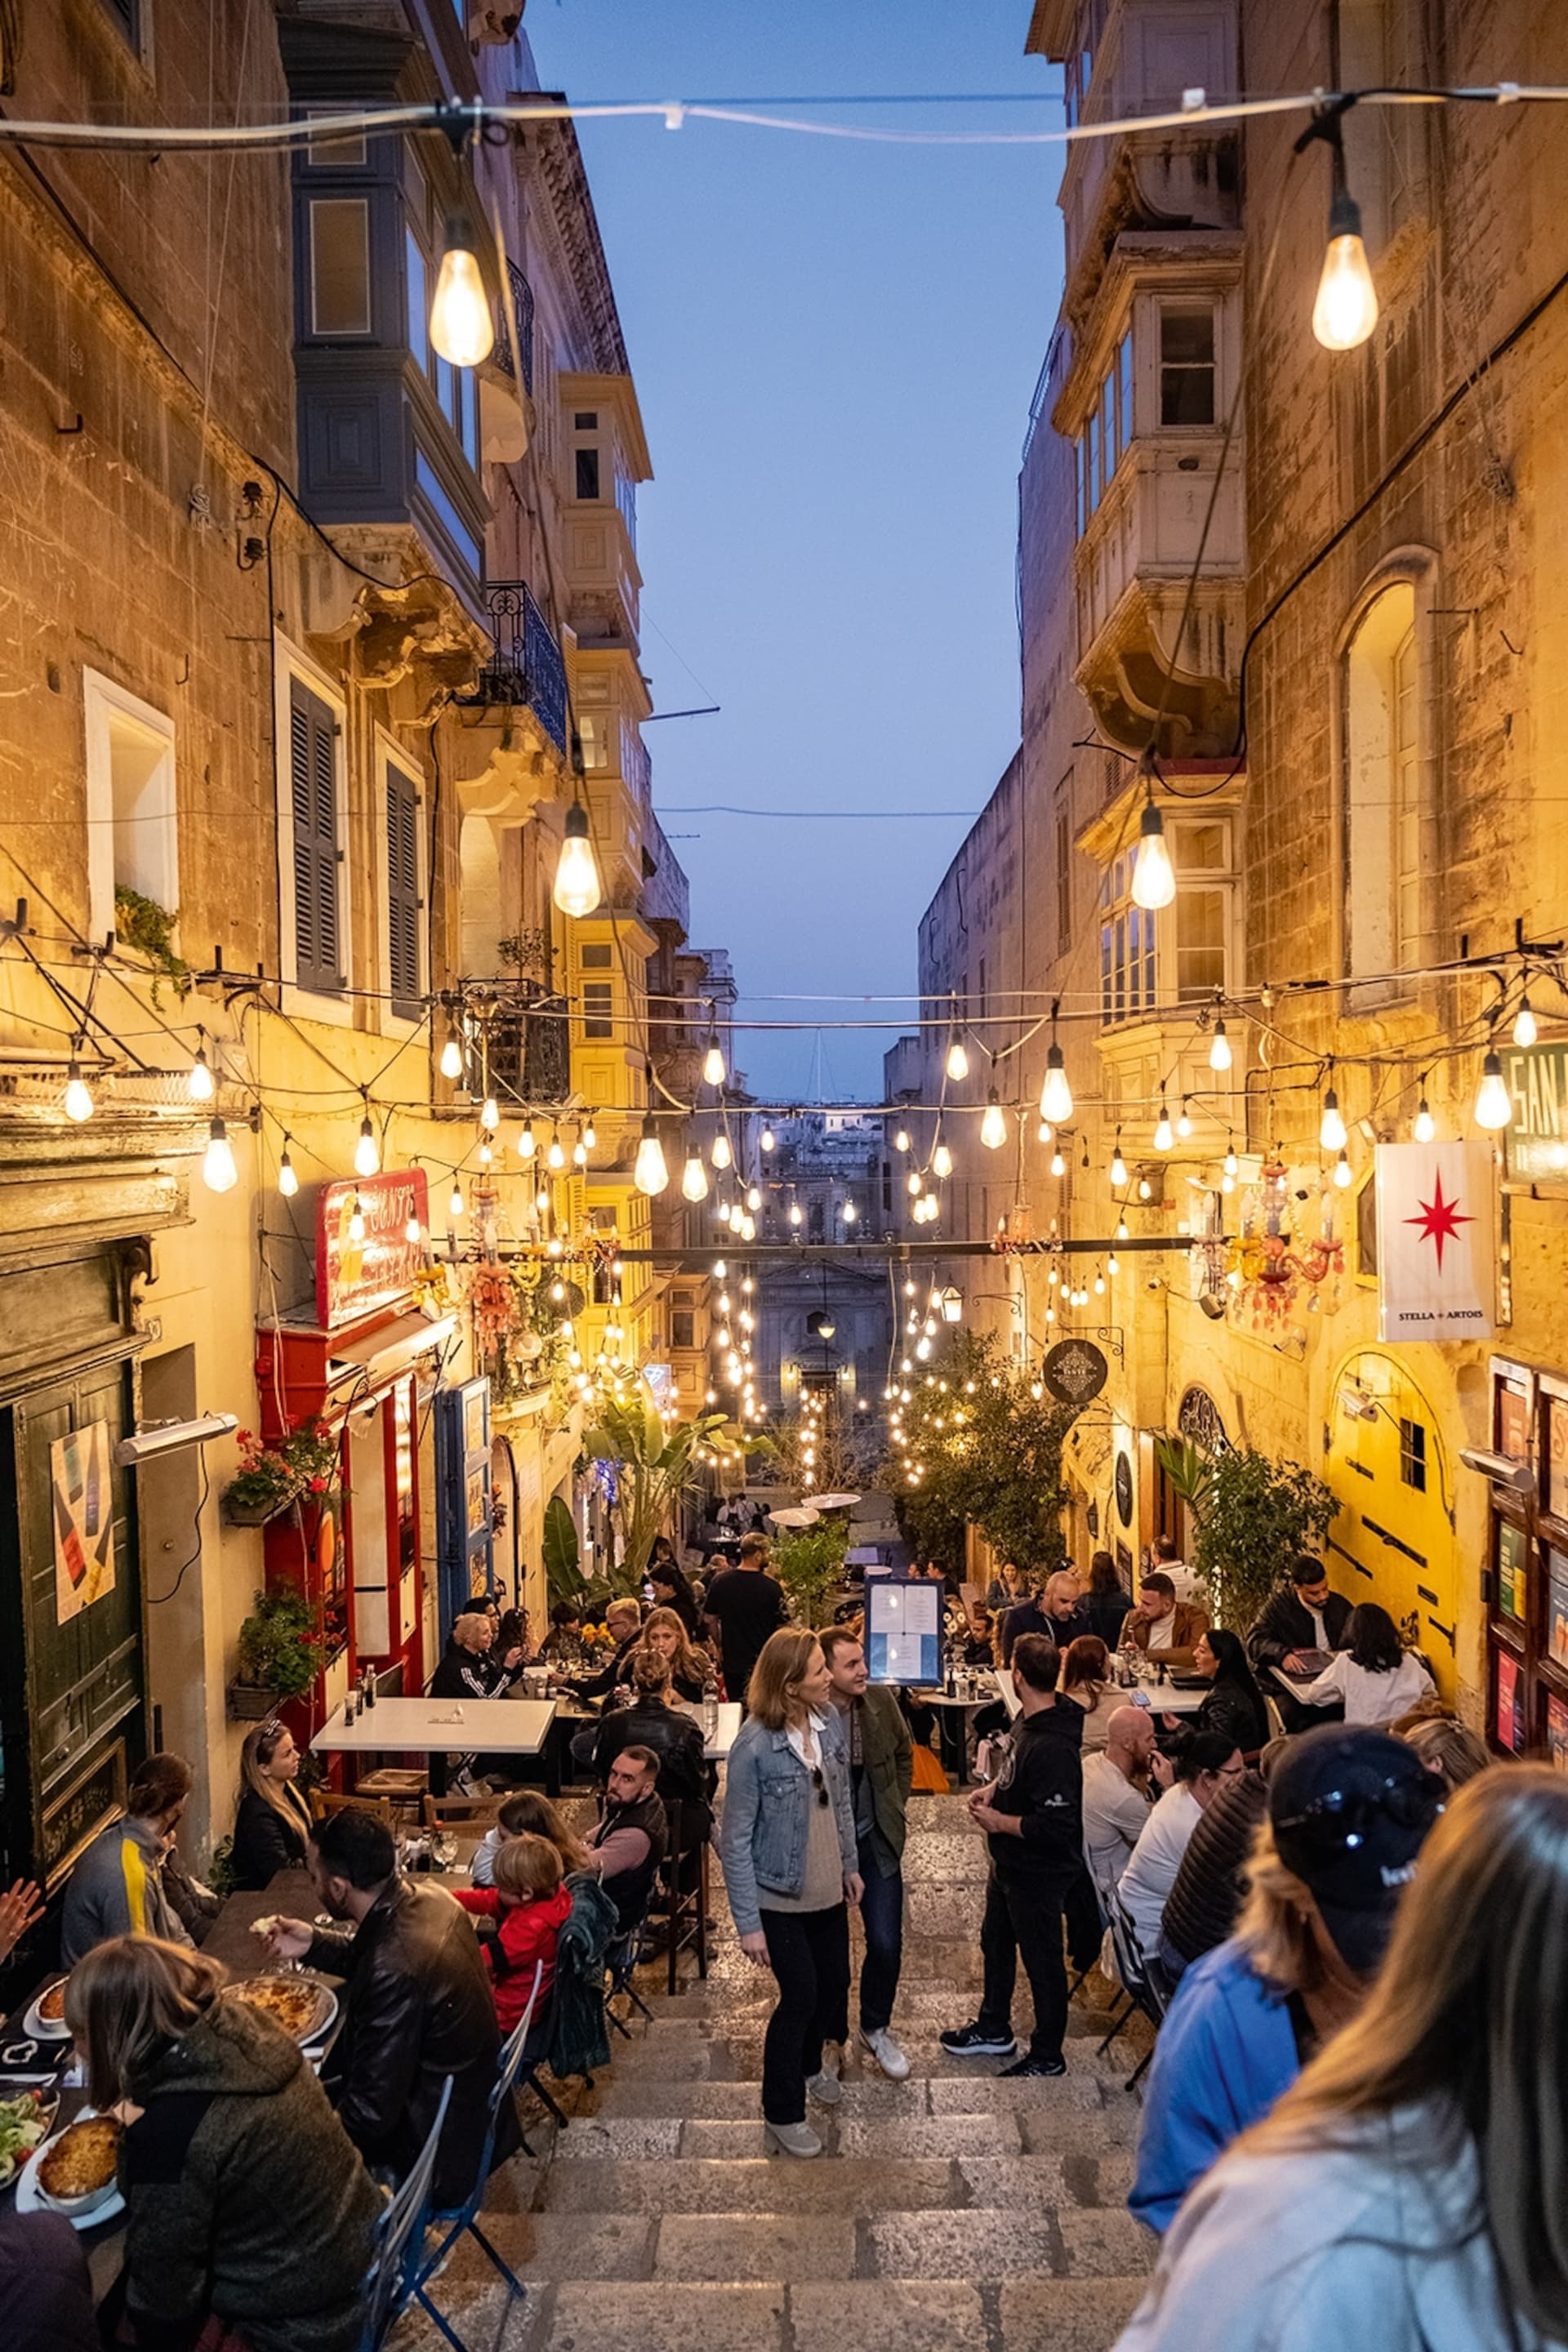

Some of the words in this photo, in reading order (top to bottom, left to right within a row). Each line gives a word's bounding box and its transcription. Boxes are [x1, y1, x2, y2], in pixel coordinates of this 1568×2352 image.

[1509, 1054, 1559, 1136] SAN
[1398, 1312, 1436, 1321] STELLA
[1446, 1310, 1483, 1320] ARTOIS
